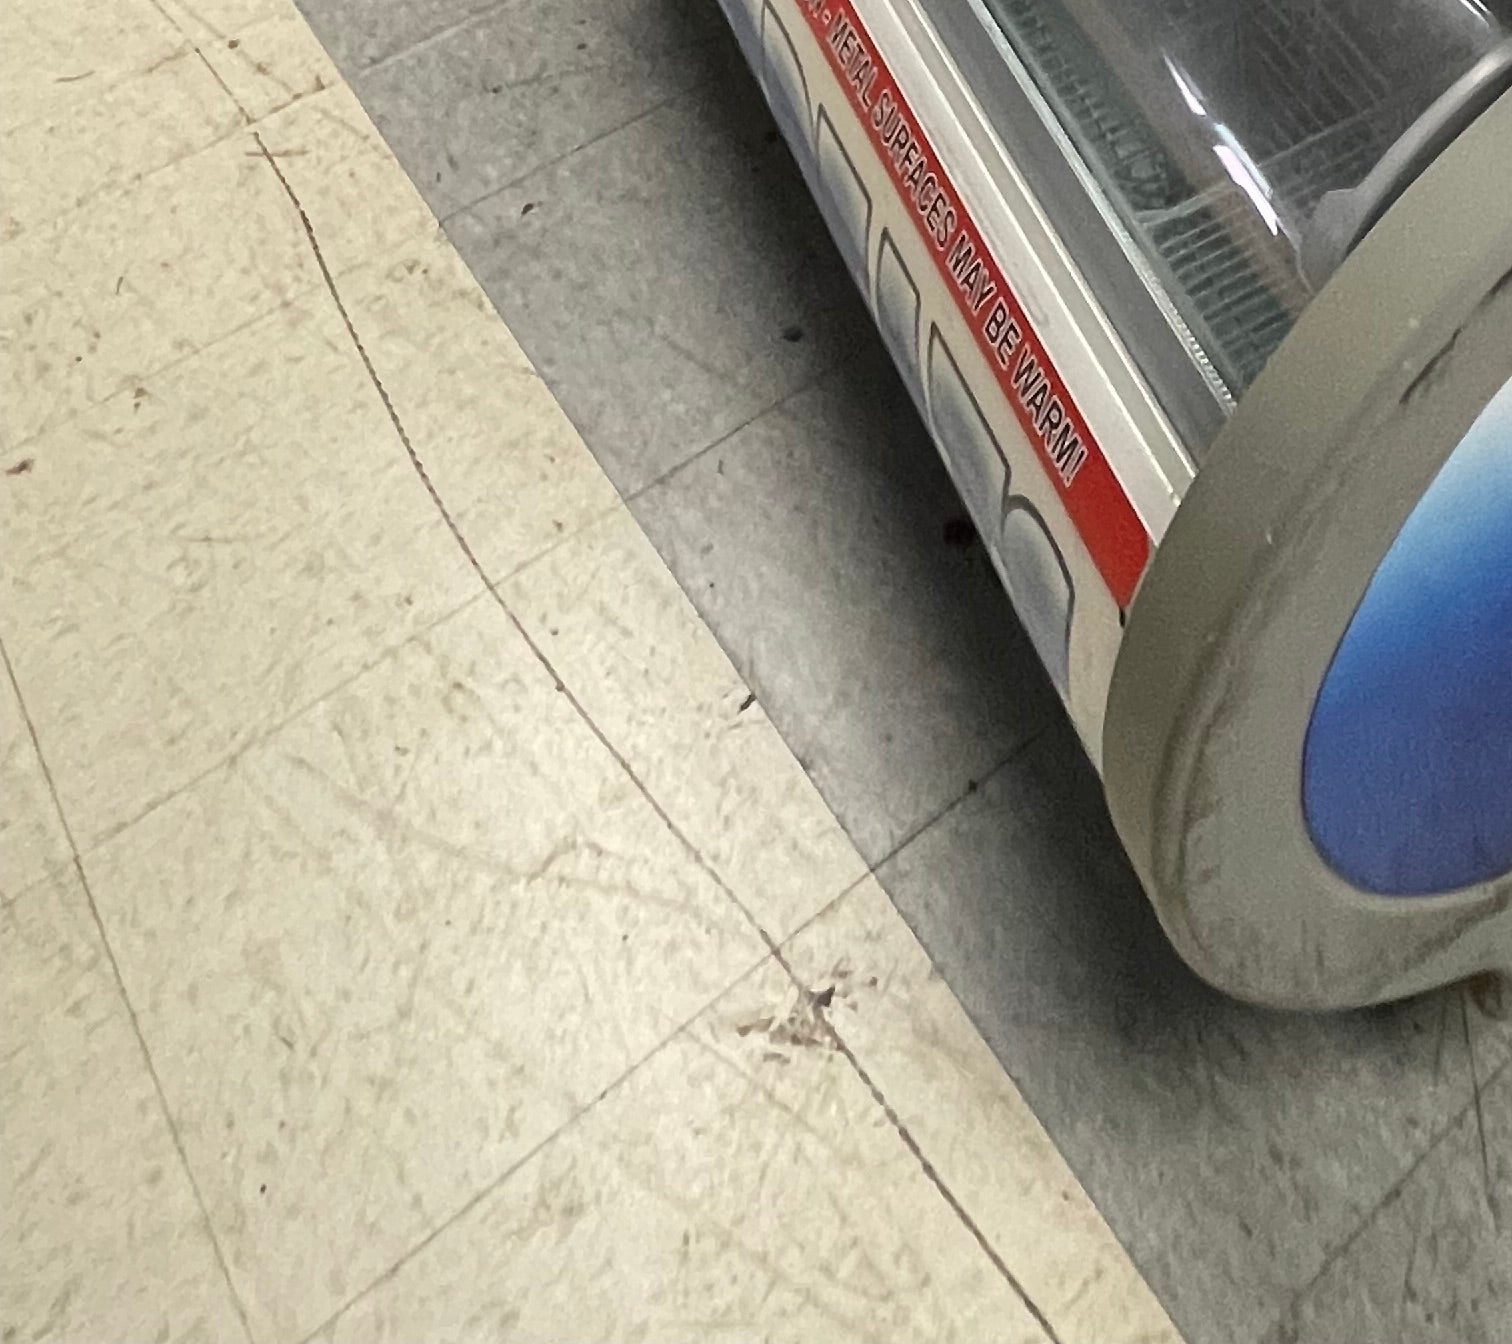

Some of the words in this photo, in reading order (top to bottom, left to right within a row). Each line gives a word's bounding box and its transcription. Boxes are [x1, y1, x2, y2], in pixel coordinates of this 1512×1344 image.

[826, 7, 879, 112] METAL
[869, 88, 957, 252] SURFACES
[945, 228, 998, 316] MAY
[983, 295, 1023, 372] BE
[1010, 342, 1089, 489] WARM!
